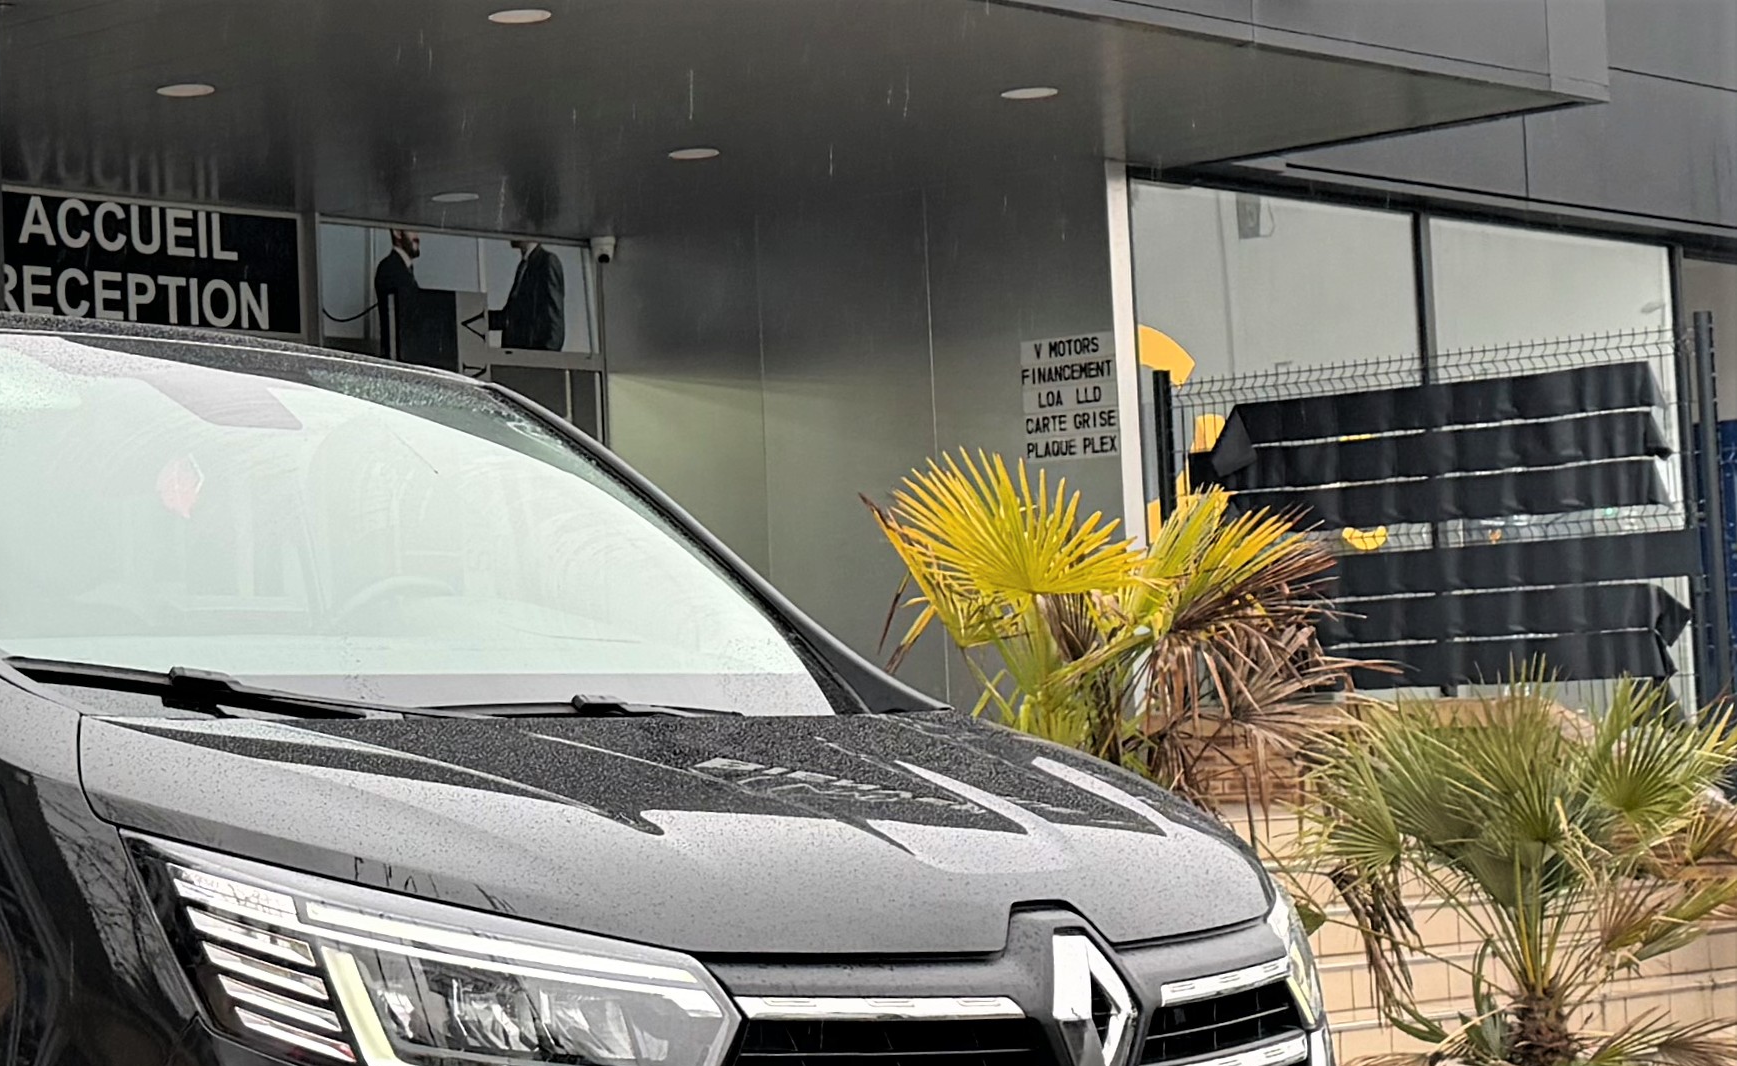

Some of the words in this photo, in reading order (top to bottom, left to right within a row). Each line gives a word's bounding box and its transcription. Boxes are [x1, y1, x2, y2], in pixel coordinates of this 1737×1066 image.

[18, 196, 239, 261] ACCUEIL
[1034, 343, 1042, 359] V
[1048, 336, 1100, 358] MOTORS
[1021, 359, 1112, 385] FINANCEMENT
[1038, 390, 1063, 408] LOA
[1076, 386, 1102, 404] LLD
[1026, 415, 1067, 434] CARTE
[1073, 410, 1116, 429] GRISE
[1083, 435, 1117, 454] PLEX
